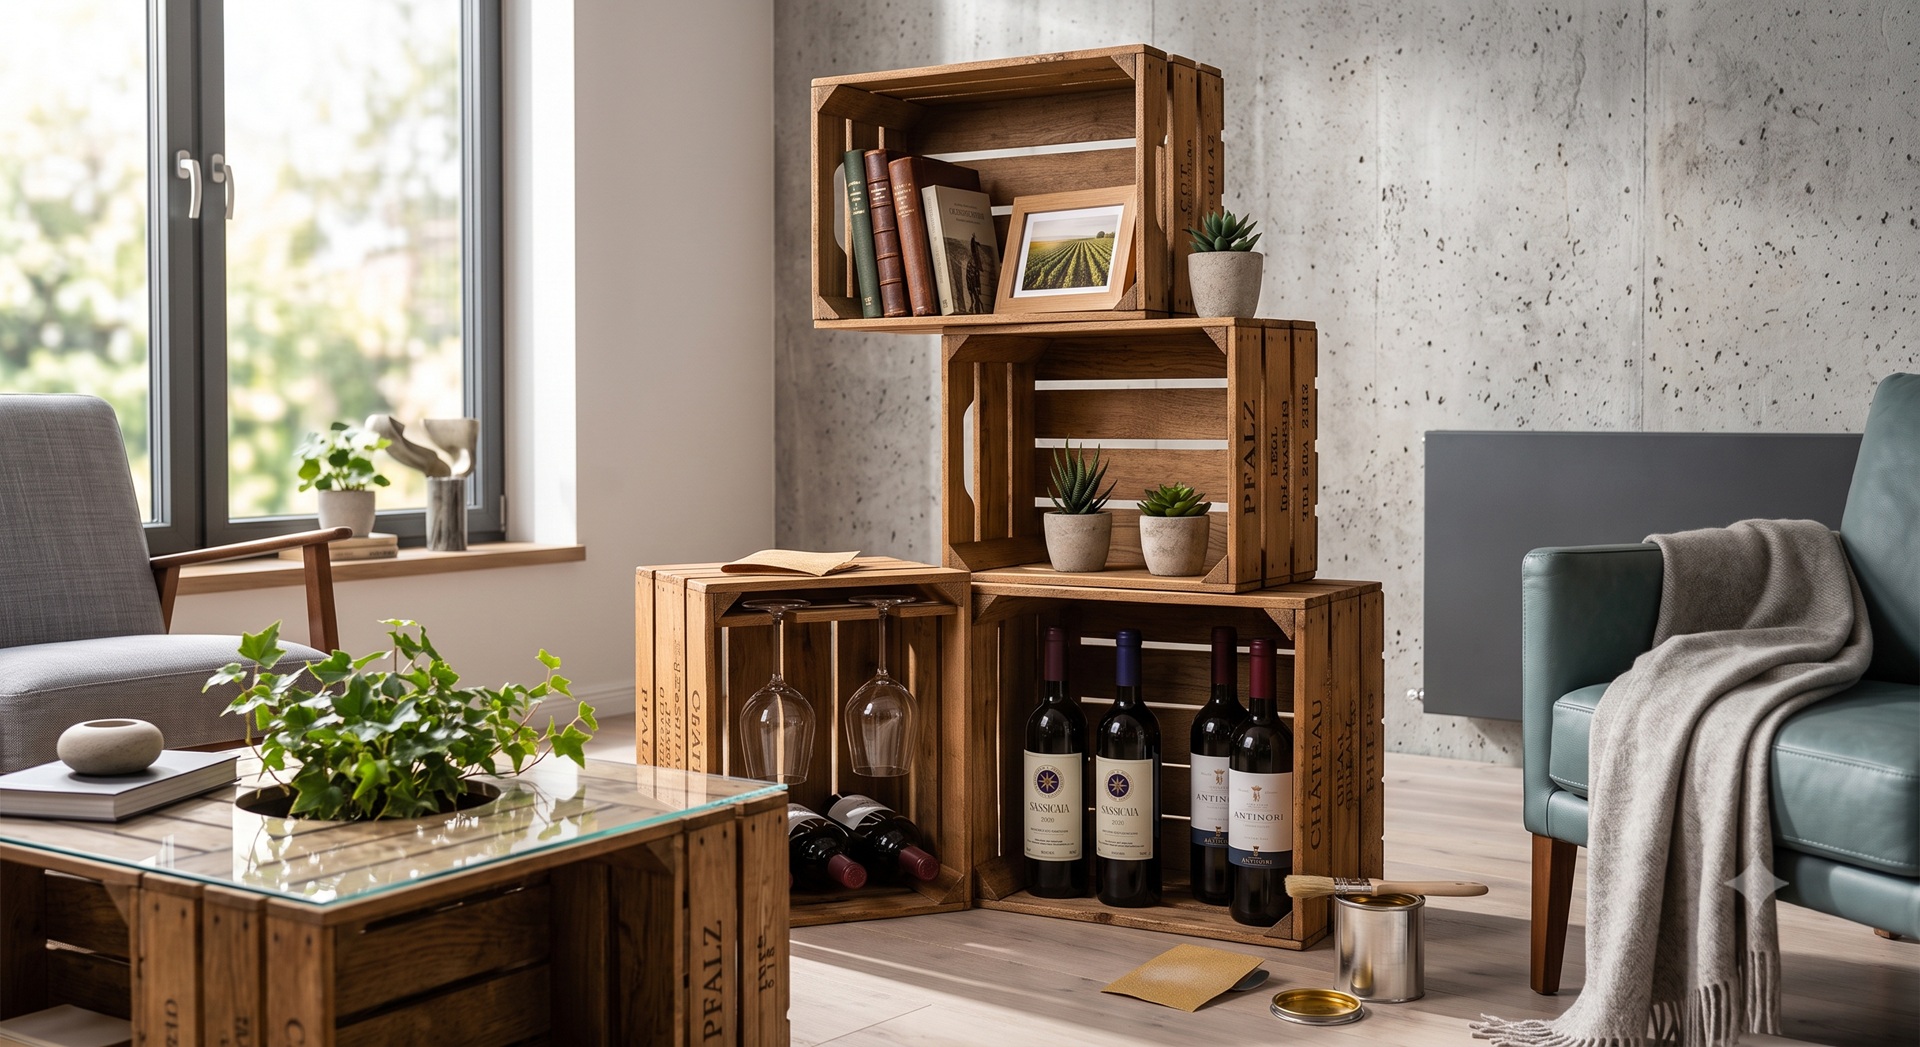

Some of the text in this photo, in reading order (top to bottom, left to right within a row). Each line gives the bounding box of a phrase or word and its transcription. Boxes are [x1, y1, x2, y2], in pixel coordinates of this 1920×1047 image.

[1243, 399, 1256, 516] PFALZ
[1029, 801, 1070, 814] SASSICAIA
[1101, 805, 1139, 817] SASSICAIA
[1234, 811, 1284, 821] ANTINORI
[704, 920, 723, 1042] PFALZ
